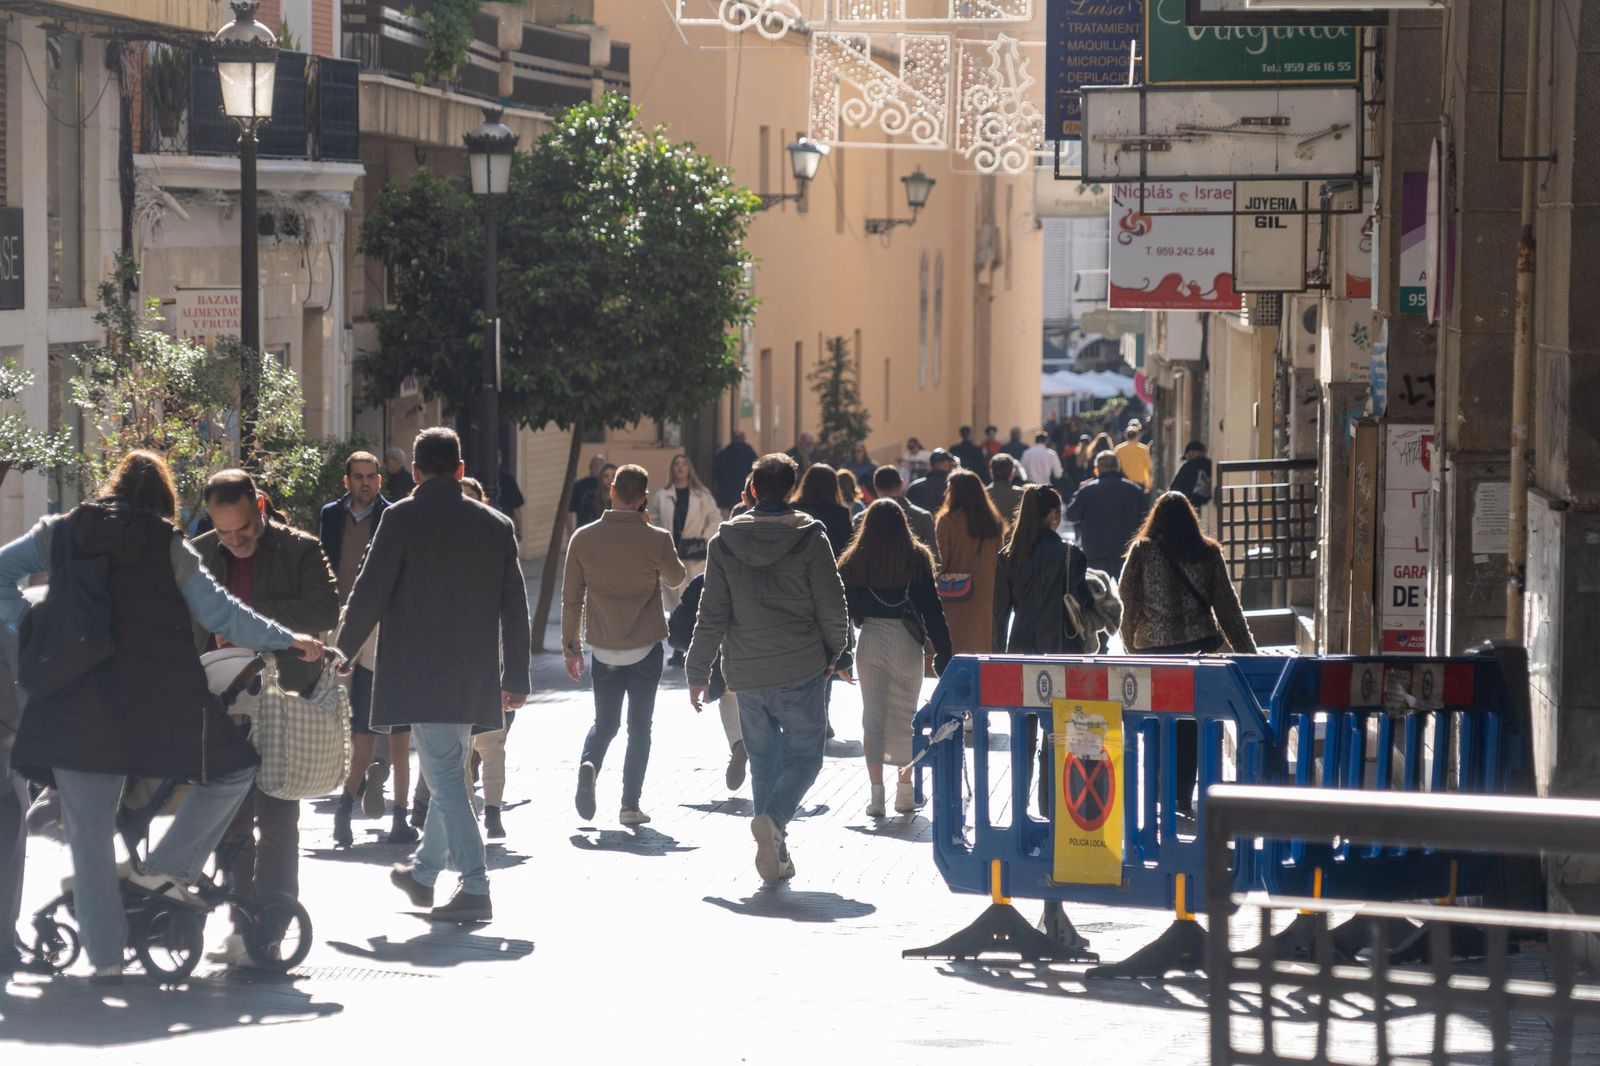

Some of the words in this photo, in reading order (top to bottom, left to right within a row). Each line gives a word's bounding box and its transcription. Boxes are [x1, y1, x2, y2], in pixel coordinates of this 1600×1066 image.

[1067, 40, 1141, 51] MAQUILLAE
[1284, 62, 1304, 73] 959
[1307, 62, 1320, 72] 26
[1323, 62, 1335, 72] 16
[1337, 61, 1351, 72] 55
[1117, 184, 1173, 199] Nicolás
[1245, 197, 1298, 210] JOYERIA
[1255, 215, 1287, 228] GIL
[197, 295, 239, 304] BAZAR
[1409, 293, 1426, 306] 95
[193, 320, 199, 329] Y
[201, 320, 242, 329] FRUTA
[1393, 564, 1428, 580] GARA
[1393, 585, 1419, 608] DE
